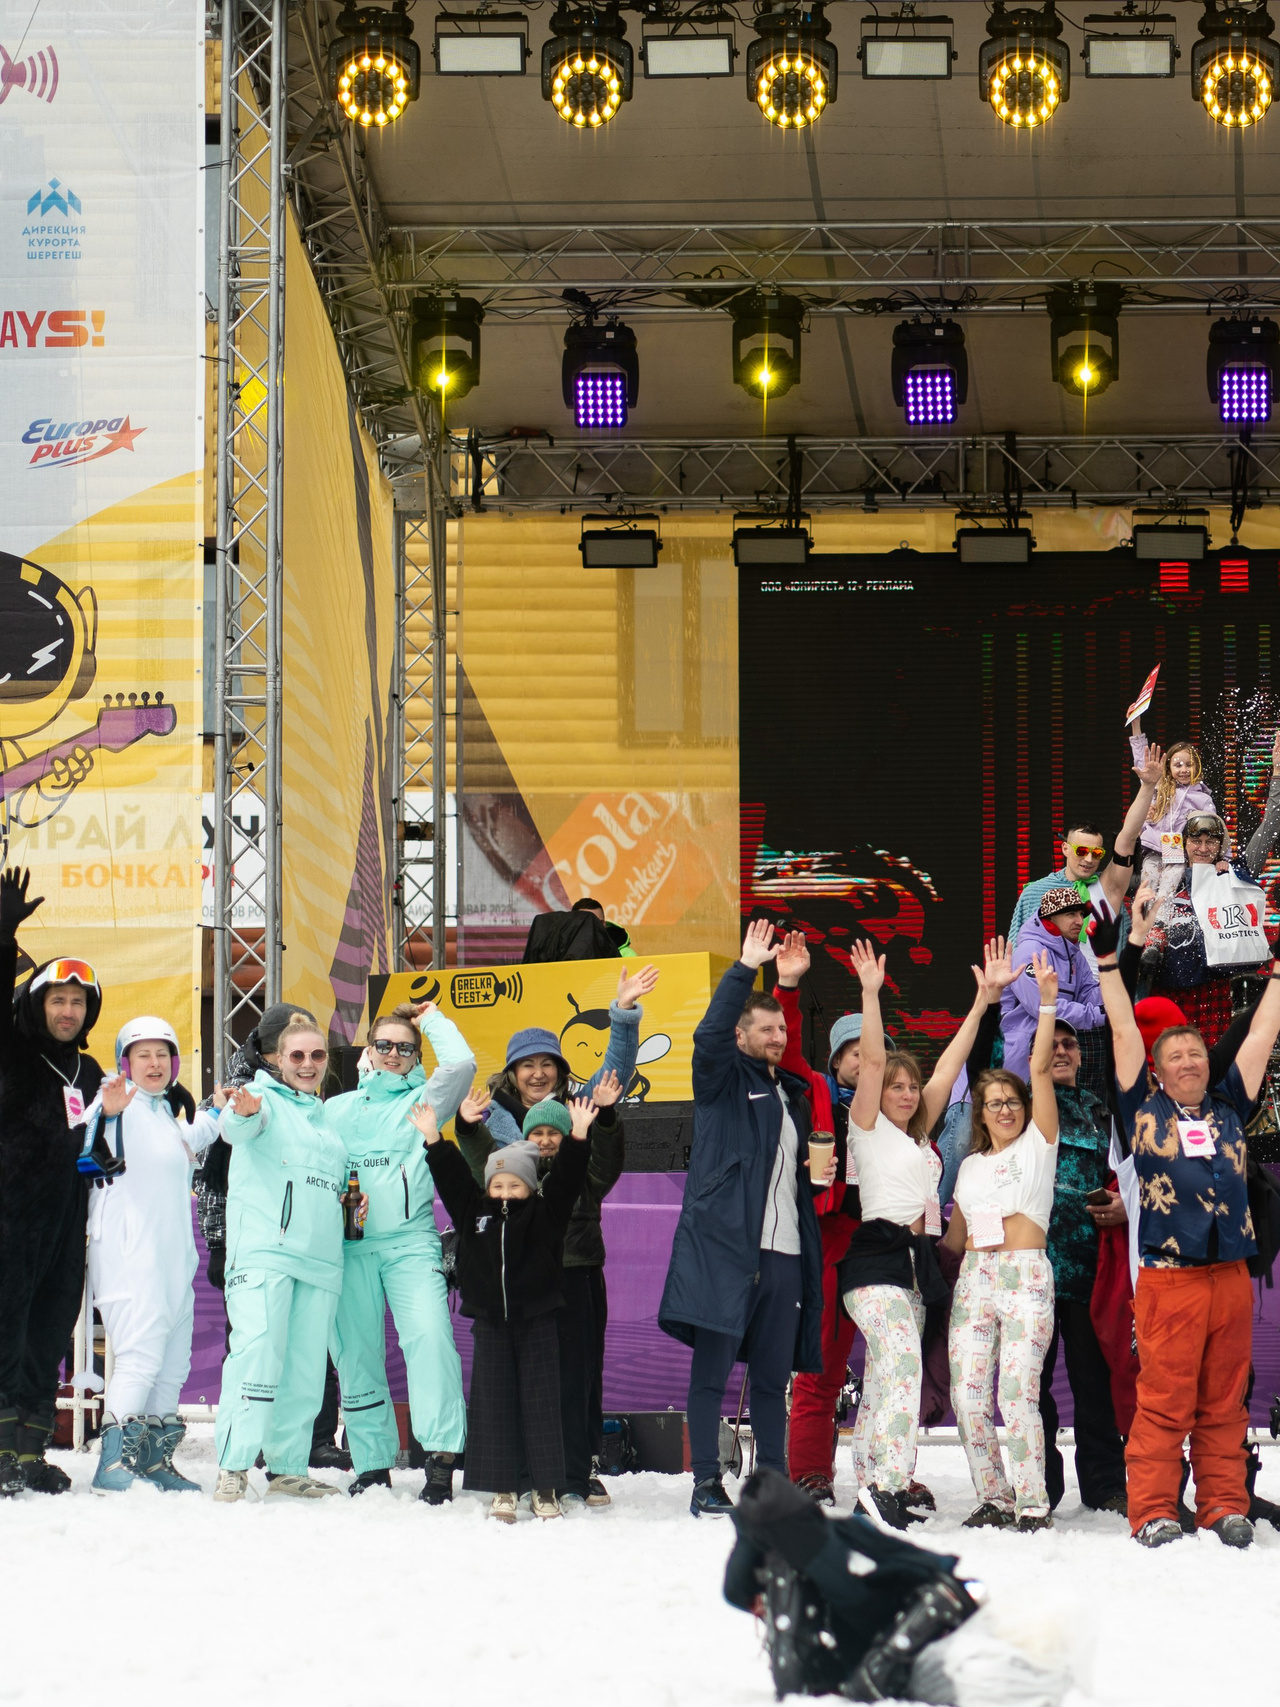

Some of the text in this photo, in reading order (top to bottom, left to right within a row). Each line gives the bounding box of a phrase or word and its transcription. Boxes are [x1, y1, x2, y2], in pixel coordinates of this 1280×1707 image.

[22, 226, 86, 236] ДИРЕКЦИЯ
[28, 238, 80, 247] КУРОРТА
[27, 251, 82, 259] ШЕРЕГЕШ
[1218, 930, 1260, 940] ROSTIC'S
[457, 977, 492, 990] GRELKA
[458, 991, 481, 1003] FEST
[363, 1157, 390, 1168] QUEEN
[306, 1176, 330, 1190] ARCTIC
[228, 1274, 248, 1289] ARCTIC
